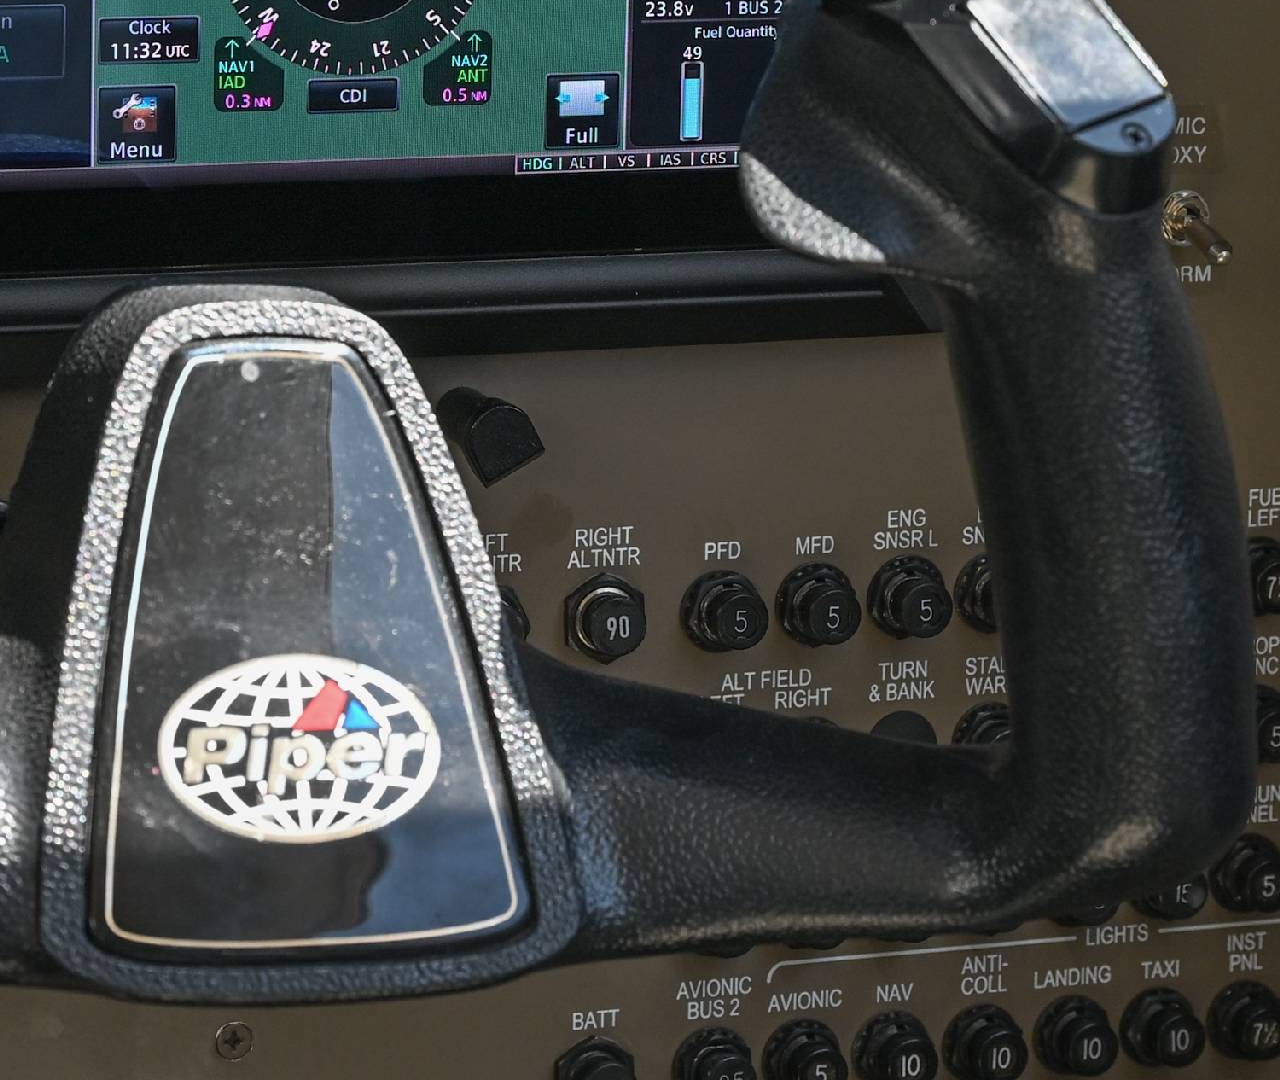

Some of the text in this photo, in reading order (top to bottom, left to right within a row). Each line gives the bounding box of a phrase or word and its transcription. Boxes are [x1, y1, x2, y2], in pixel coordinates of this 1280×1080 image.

[129, 20, 171, 35] Clock
[340, 89, 367, 104] CDI
[566, 128, 598, 144] Full
[110, 142, 163, 158] Menu
[575, 526, 634, 548] RIGHT
[795, 536, 834, 555] MFD
[567, 547, 641, 568] ALTNTR
[705, 542, 741, 560] PFD
[183, 724, 426, 796] Piper
[1086, 924, 1149, 946] LIGHTS
[1034, 966, 1112, 990] LANDING
[1141, 960, 1180, 980] TAXI
[768, 989, 843, 1013] AVIONIC
[572, 1009, 620, 1030] BATT
